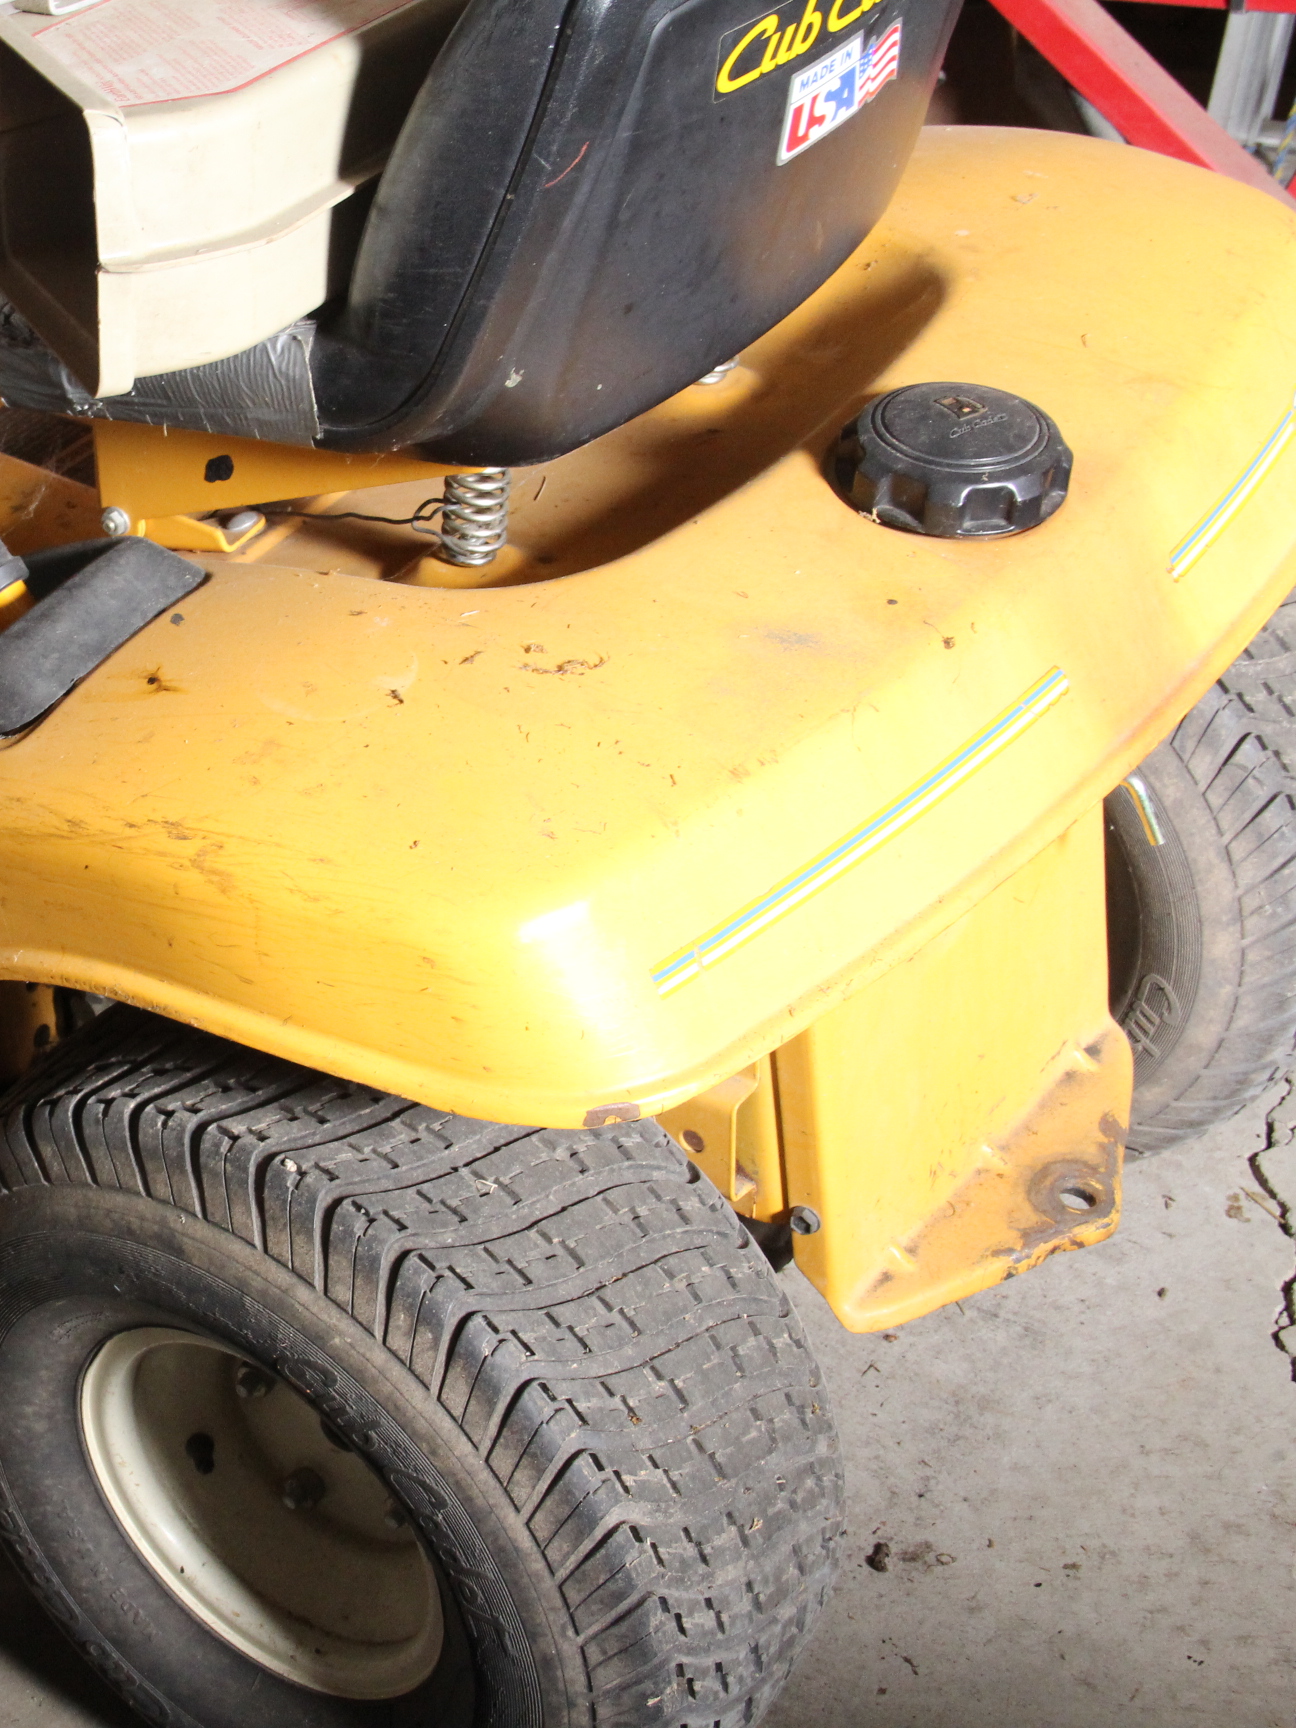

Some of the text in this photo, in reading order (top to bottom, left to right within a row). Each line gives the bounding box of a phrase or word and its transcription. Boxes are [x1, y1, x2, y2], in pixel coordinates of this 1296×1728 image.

[716, 0, 823, 94] Cub
[799, 46, 855, 93] MADE IN
[785, 63, 858, 153] USA
[950, 424, 971, 439] Cub
[1124, 972, 1180, 1058] Cub
[278, 1354, 521, 1657] Cub Cadet
